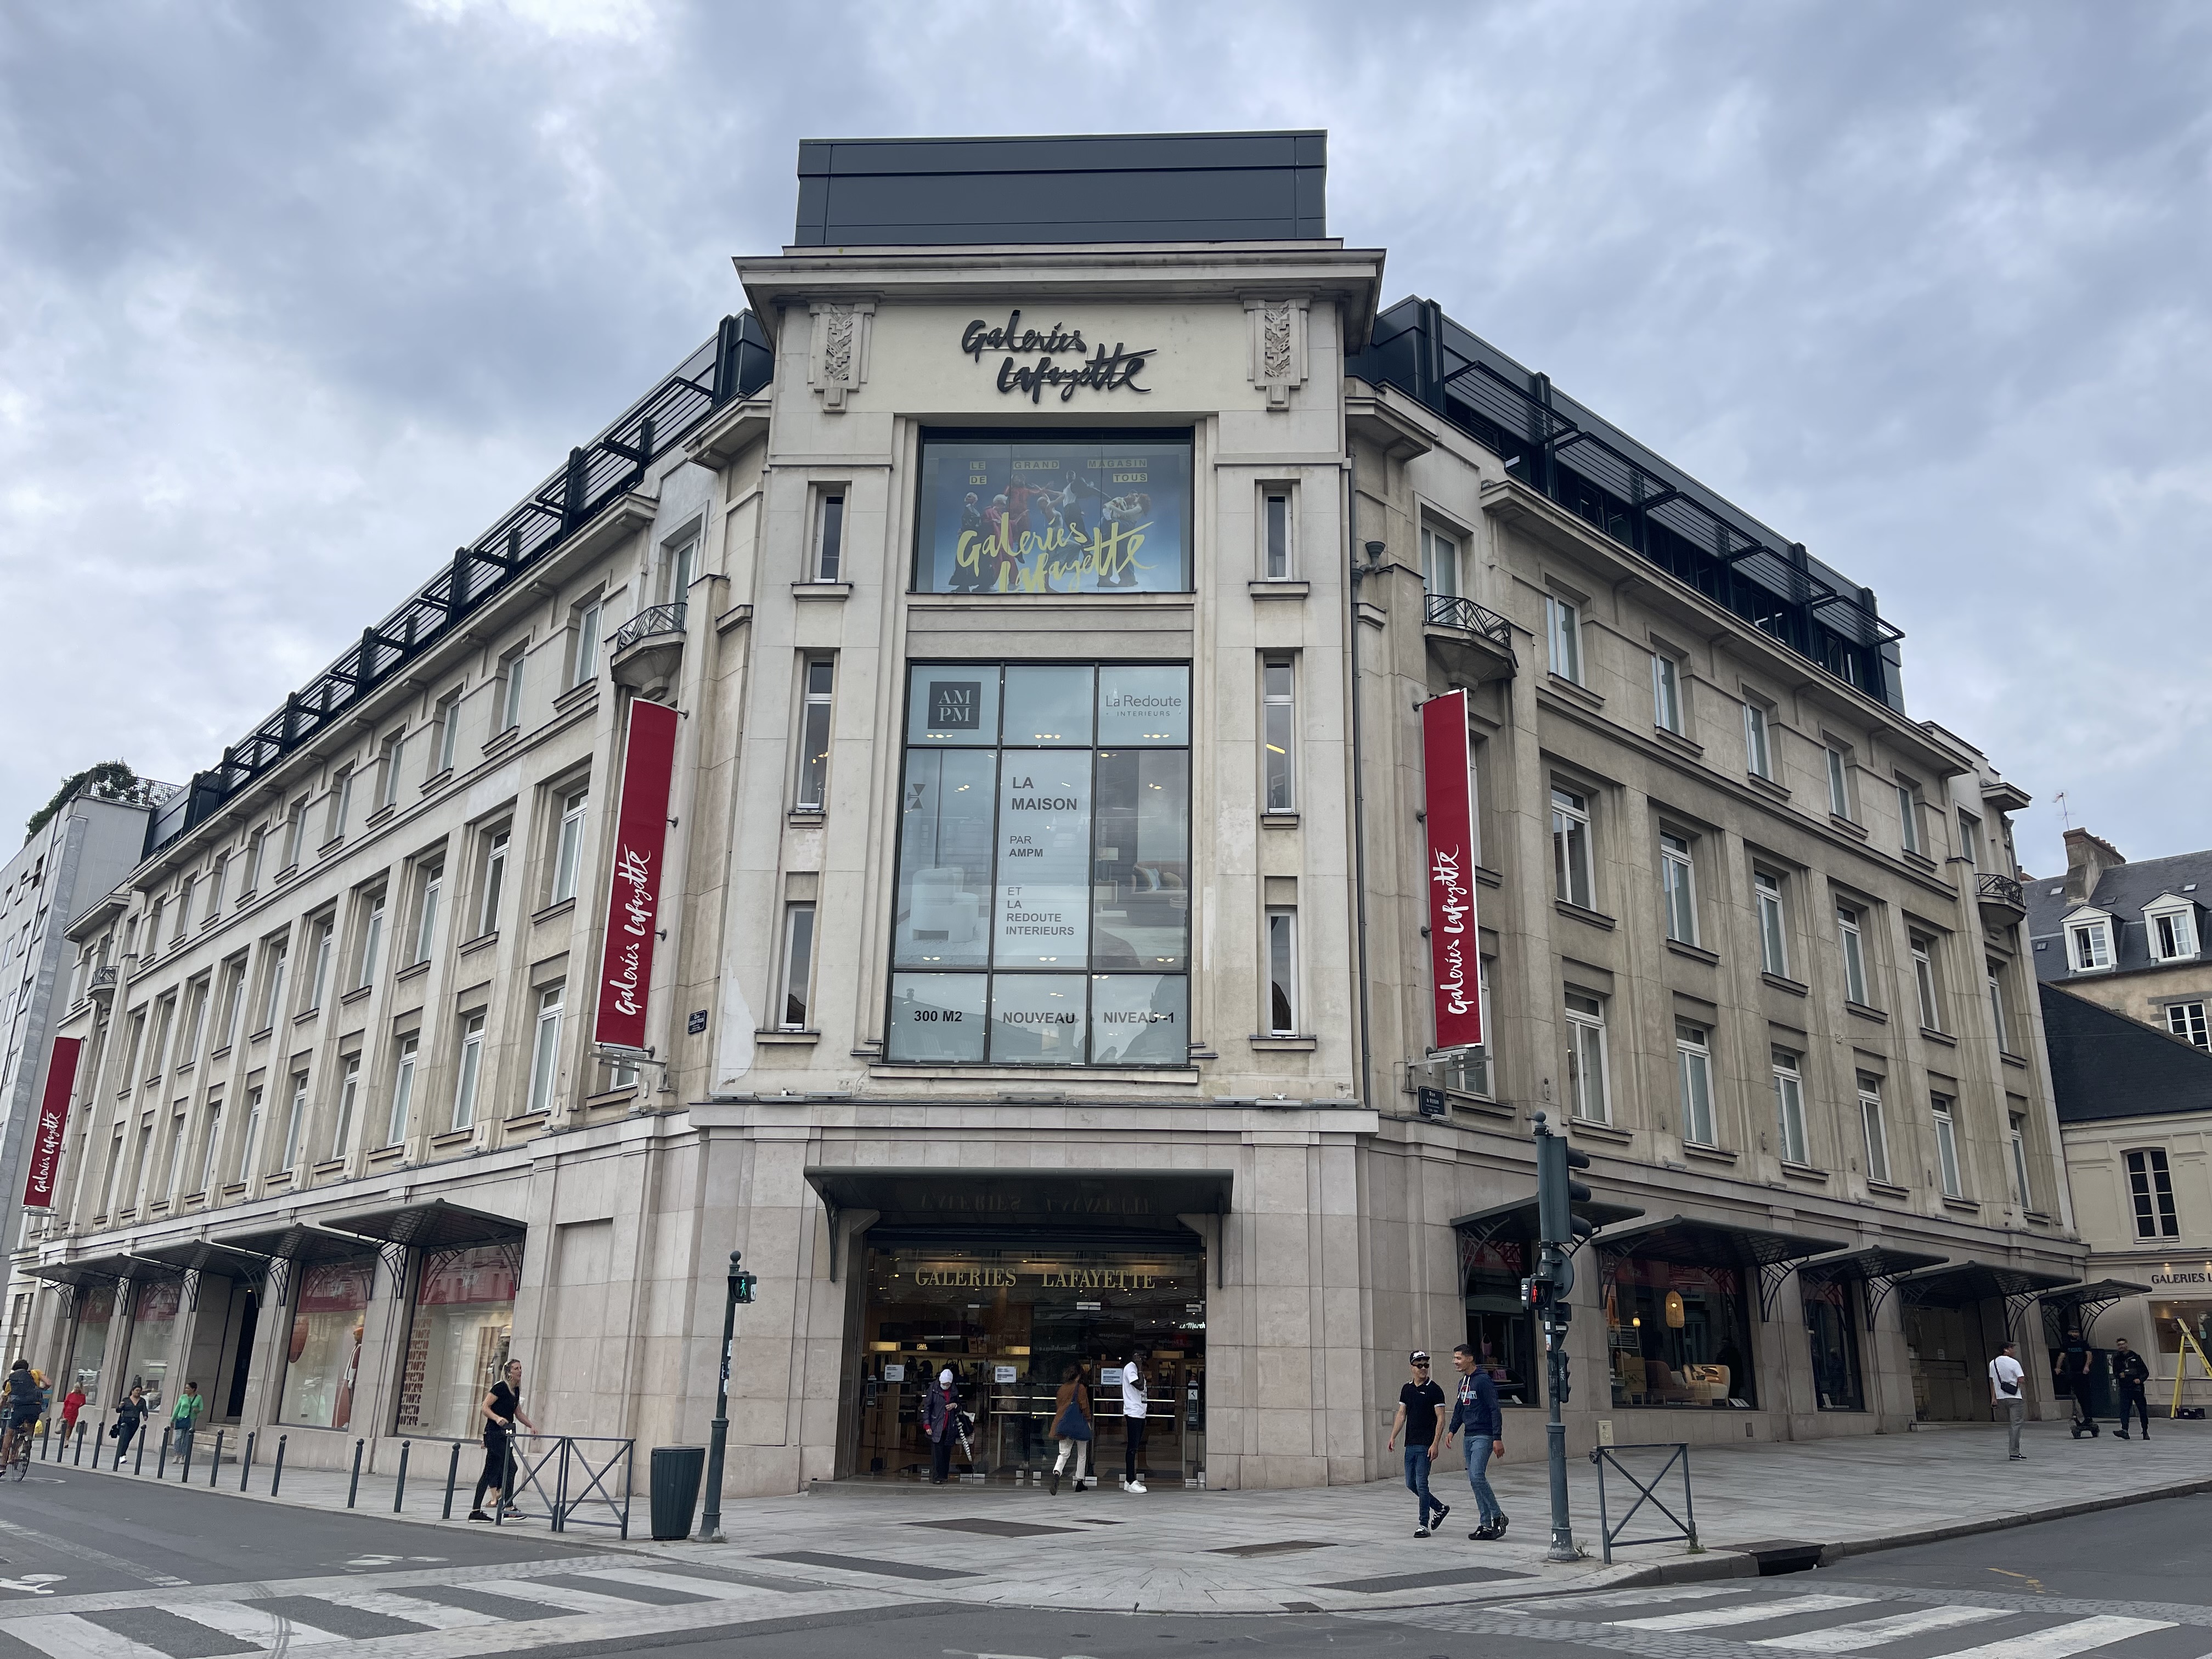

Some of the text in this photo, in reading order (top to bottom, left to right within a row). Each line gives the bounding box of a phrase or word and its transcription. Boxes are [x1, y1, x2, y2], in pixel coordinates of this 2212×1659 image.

[962, 309, 1087, 363] Galeries
[997, 342, 1157, 404] Lafayette
[971, 459, 1147, 470] LE GRAND MAGASIN
[971, 473, 1147, 484] DE TOUS
[957, 512, 1088, 577] Galeries
[938, 690, 971, 704] AM
[1106, 695, 1182, 707] La Redoute
[939, 707, 970, 722] PM
[1013, 777, 1034, 789] LA
[1012, 798, 1077, 810] MAISON
[1009, 836, 1032, 844] PAR
[1009, 848, 1043, 857] AMPM
[1008, 887, 1022, 896] ET
[1007, 900, 1022, 909] LA
[1007, 913, 1062, 922] REDOUTE
[609, 843, 652, 1015] Galeries Lafayette
[1006, 926, 1074, 935] INTERIEURS
[1432, 843, 1474, 1014] Galeries Lafayette
[913, 1011, 962, 1022] 300 M2
[1003, 1012, 1075, 1024] NOUVEAU
[1103, 1012, 1175, 1024] NIVEAU -1
[32, 1109, 61, 1193] Galeries Lafayette
[915, 1266, 1155, 1289] GALERIES LAFAYETTE
[2151, 1273, 2205, 1284] GALERIES
